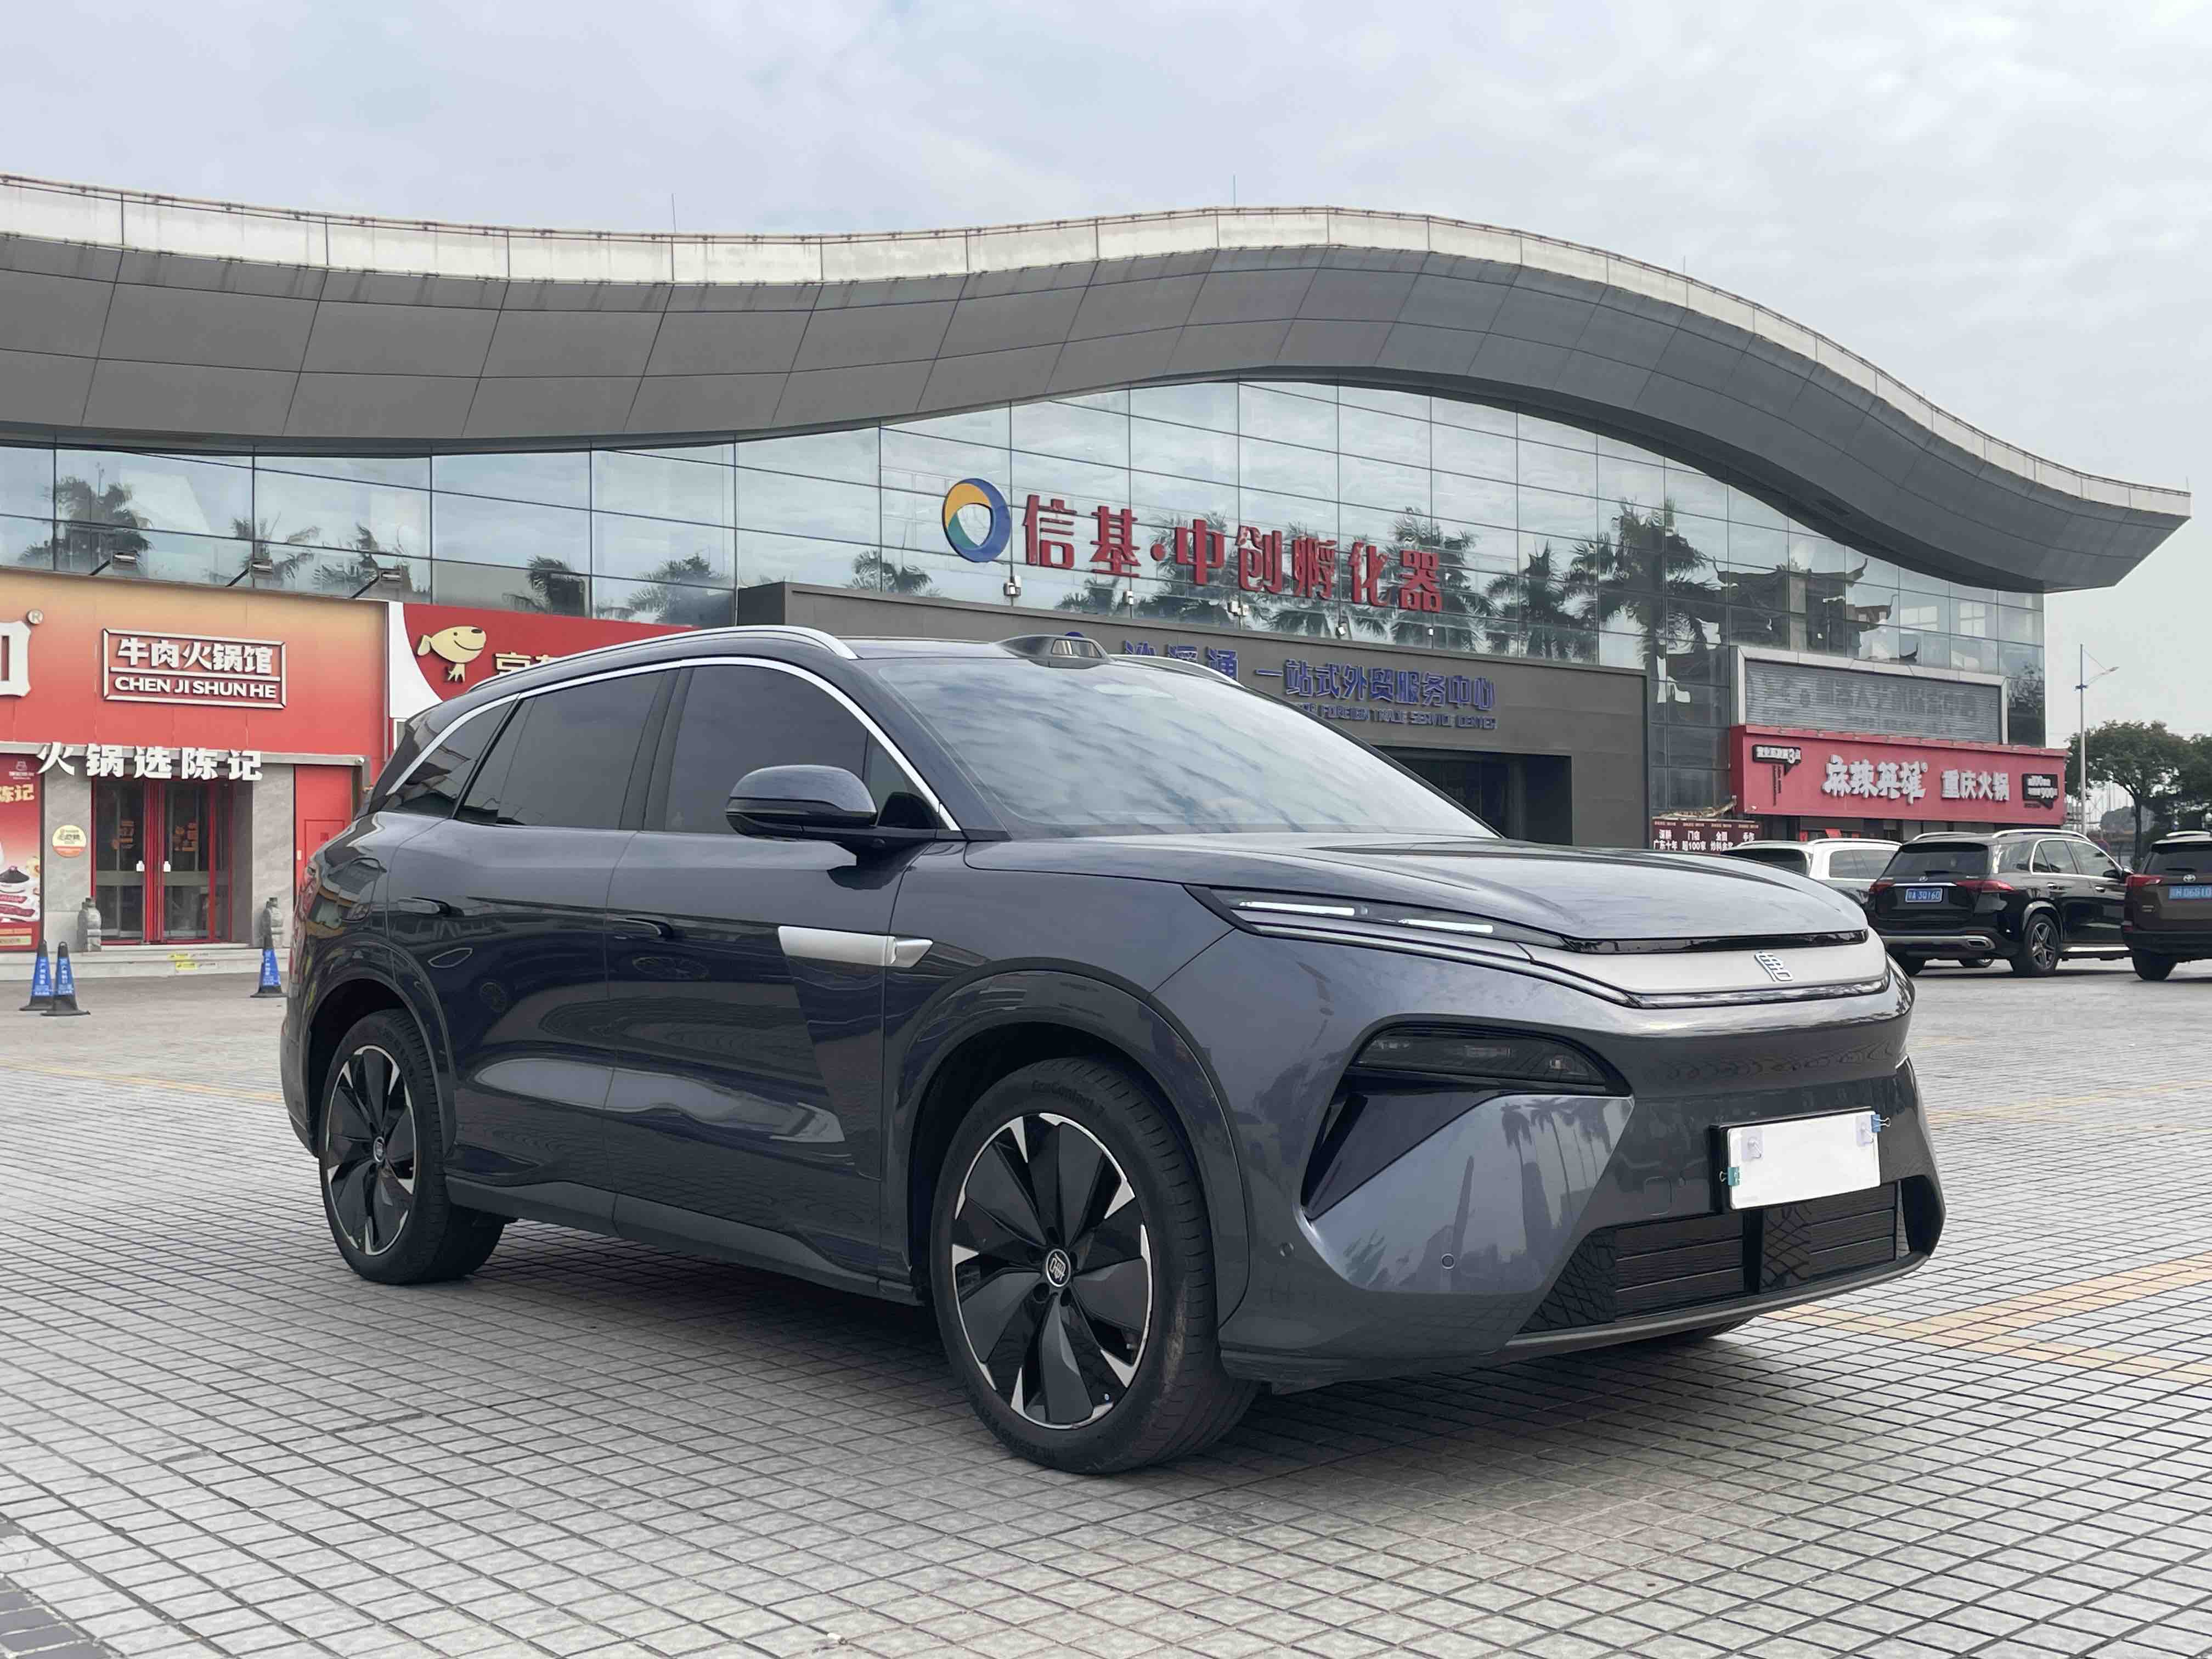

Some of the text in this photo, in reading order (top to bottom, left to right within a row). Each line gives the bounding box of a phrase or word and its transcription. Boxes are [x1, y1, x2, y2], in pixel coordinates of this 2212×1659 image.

[117, 637, 273, 675] 牛肉火锅馆
[114, 676, 276, 698] CHEN JI SHUN HE
[1255, 658, 1496, 710] 一站式外贸服务中心
[1410, 711, 1455, 726] SERVICE
[1458, 715, 1497, 729] CENTER
[37, 741, 263, 781] 火锅选陈记
[1941, 769, 2010, 802] 重庆火锅
[1687, 830, 1701, 840] 门店
